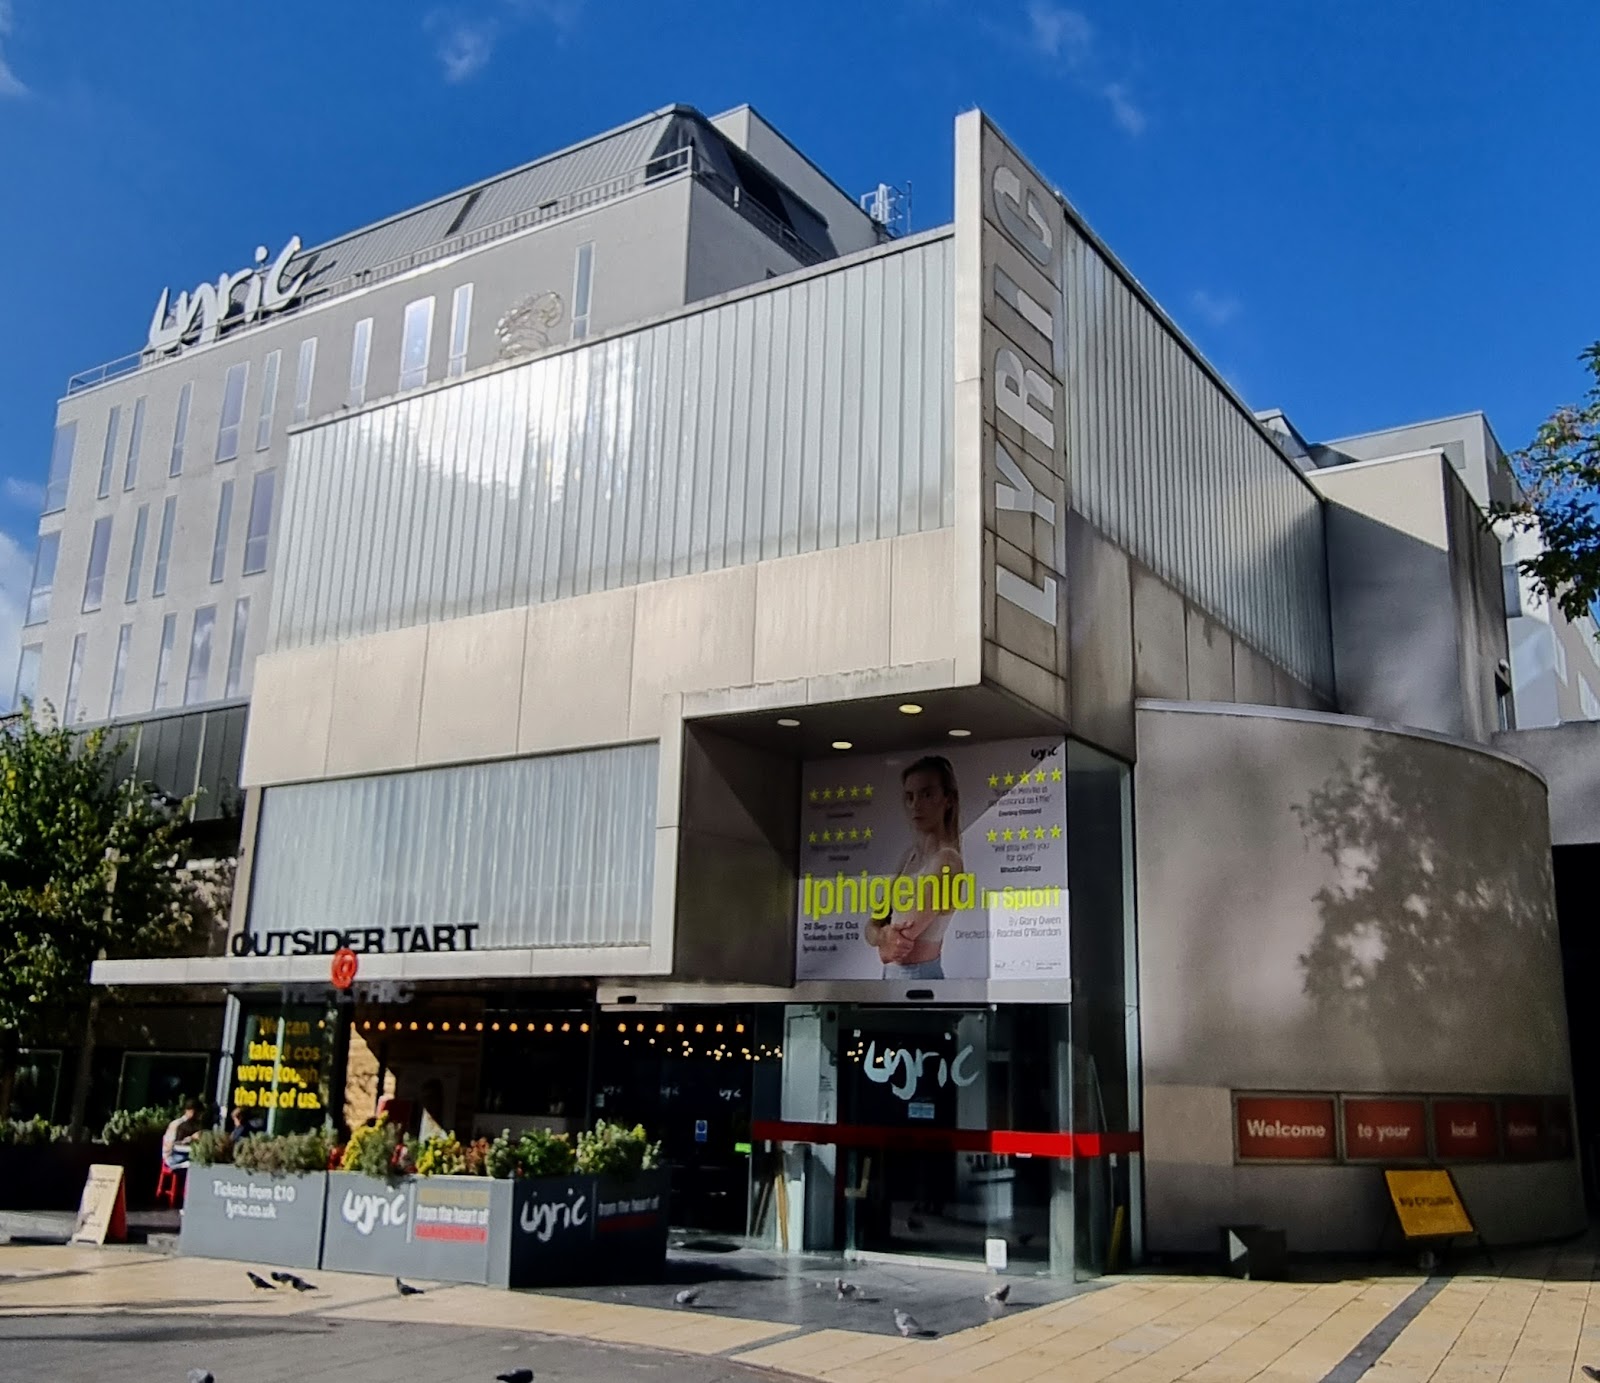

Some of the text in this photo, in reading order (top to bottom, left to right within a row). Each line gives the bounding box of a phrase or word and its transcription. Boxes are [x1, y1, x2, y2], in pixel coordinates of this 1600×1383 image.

[993, 163, 1057, 626] LYRIC
[804, 866, 976, 920] Iphigenia
[981, 887, 998, 909] in
[845, 921, 859, 929] Oct
[1019, 916, 1037, 926] Gary
[1038, 915, 1062, 925] Owen
[231, 924, 479, 956] OUTSIDER TART
[996, 929, 1023, 938] Rachel
[248, 1039, 280, 1061] take
[233, 1086, 321, 1110] the lot of us.
[1247, 1119, 1327, 1138] Welcome
[1357, 1123, 1373, 1139] to
[1375, 1125, 1411, 1142] your
[213, 1180, 248, 1199] Tickets
[248, 1182, 273, 1200] from
